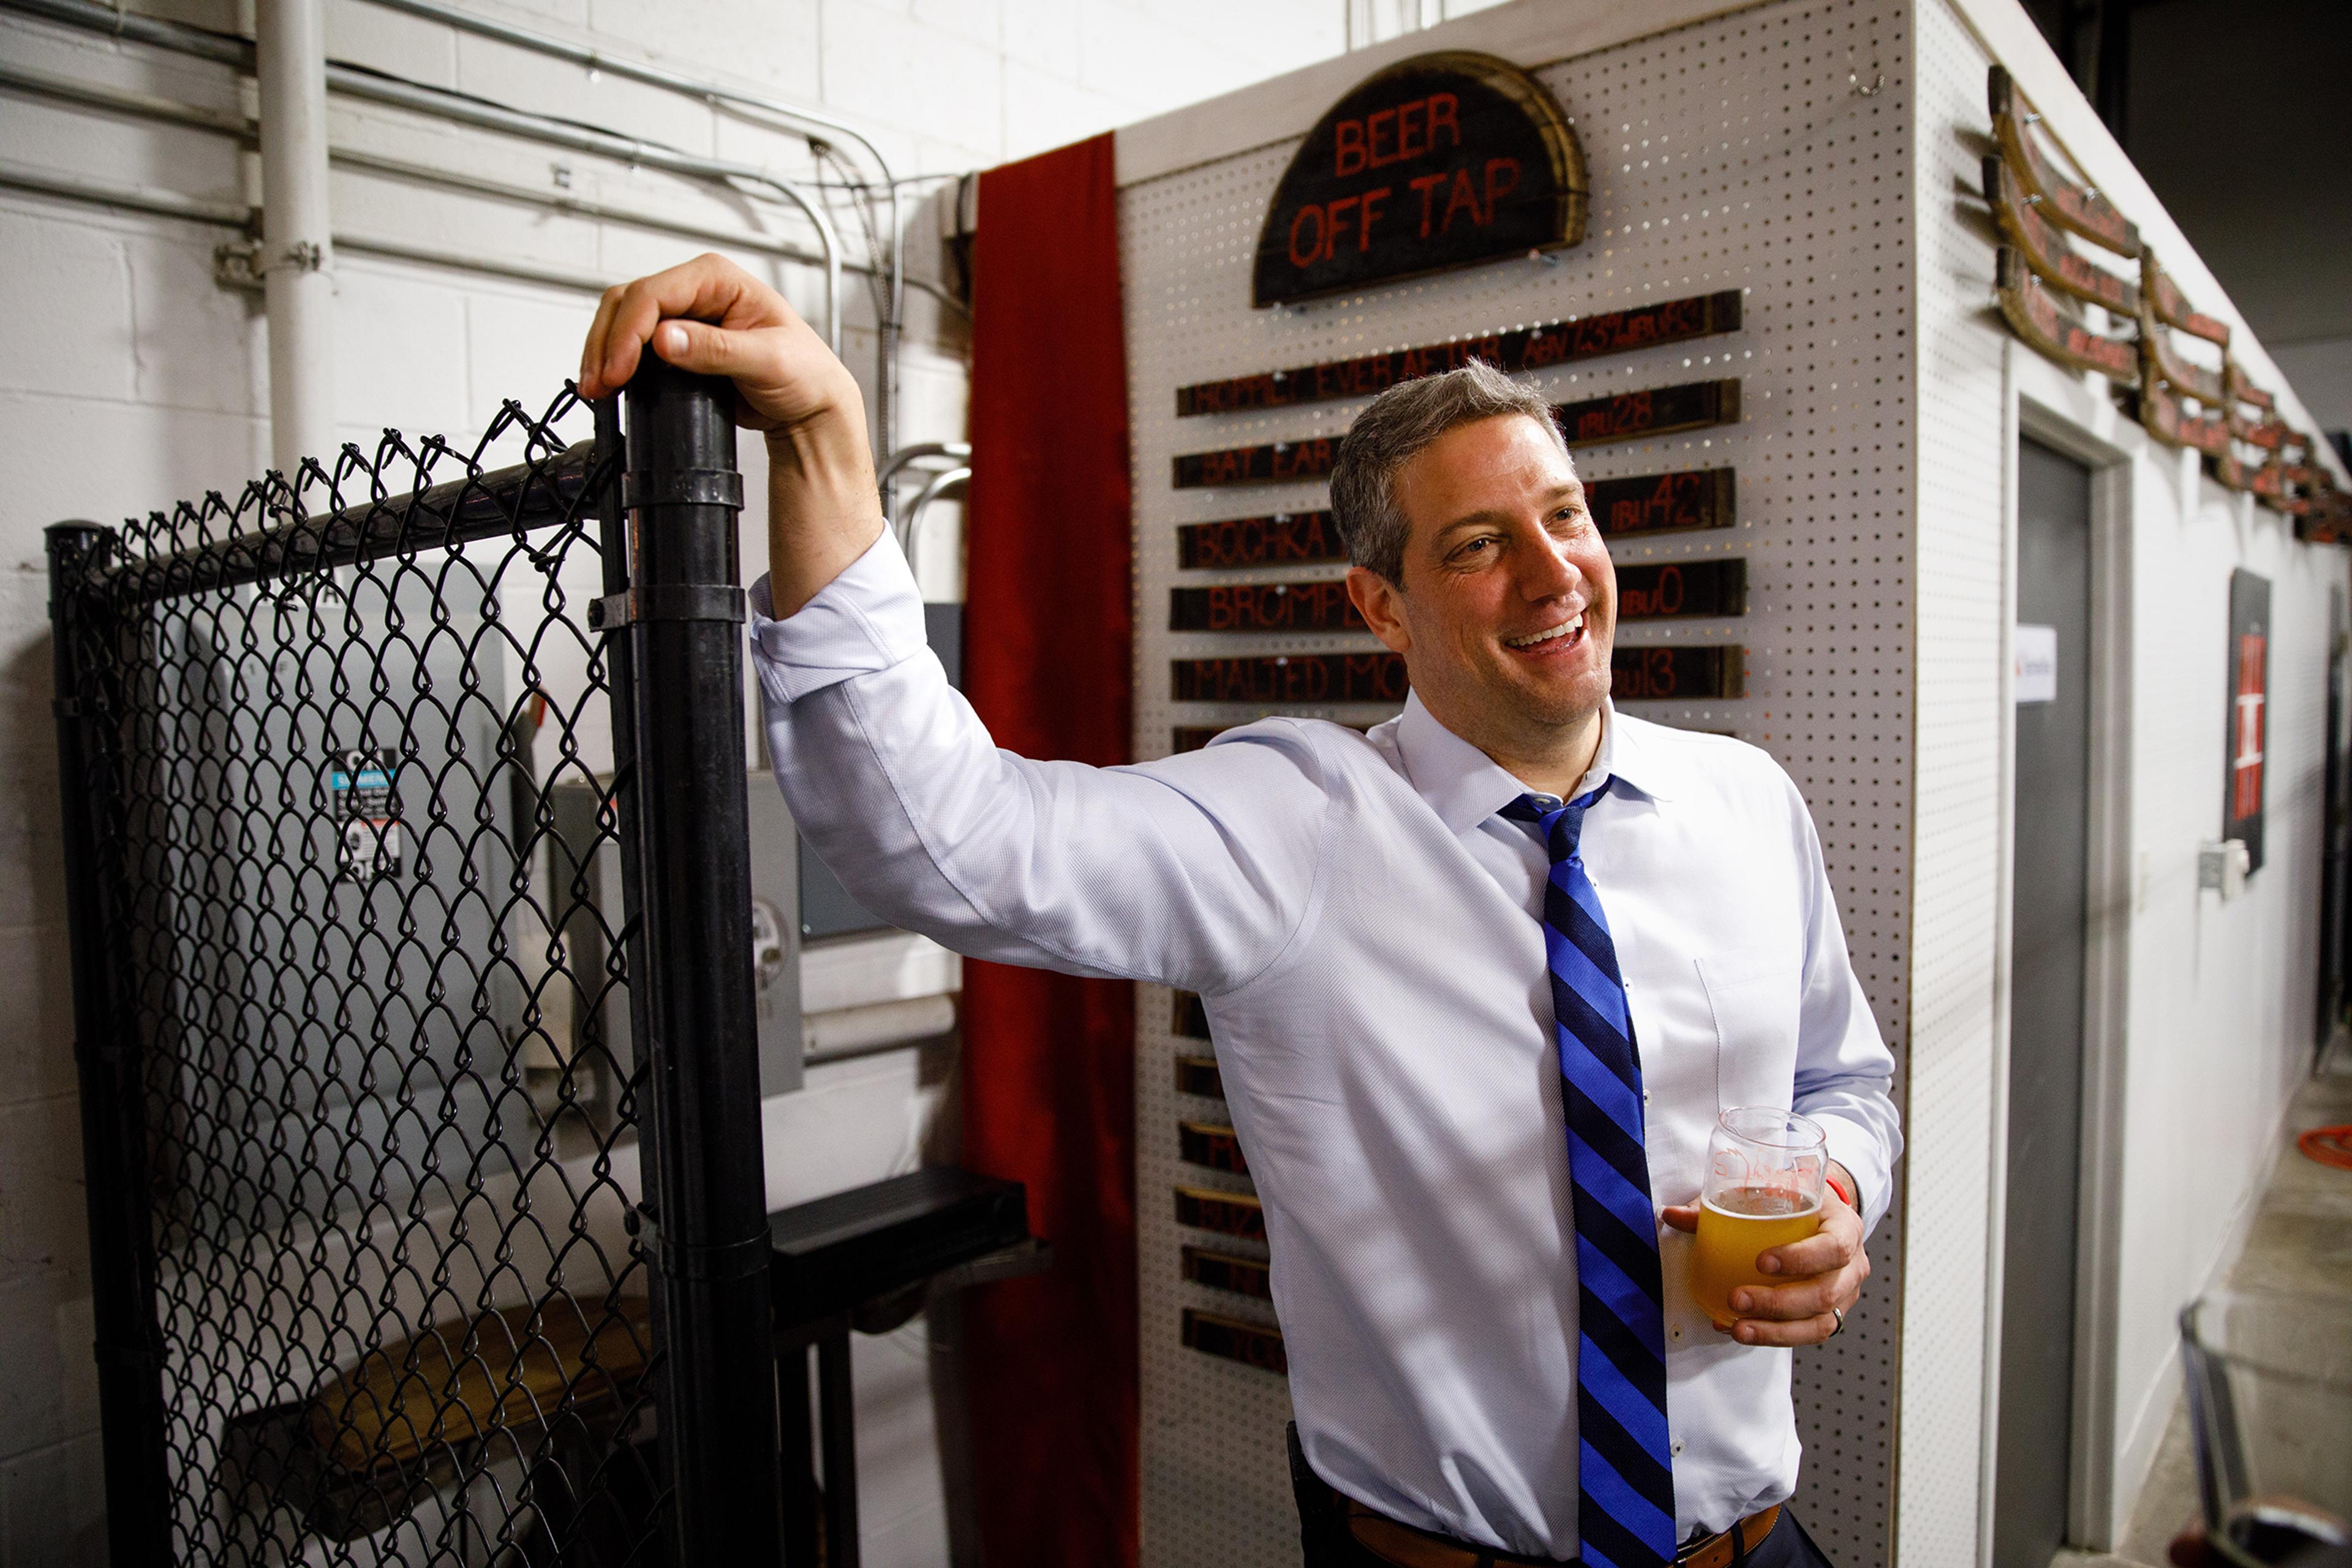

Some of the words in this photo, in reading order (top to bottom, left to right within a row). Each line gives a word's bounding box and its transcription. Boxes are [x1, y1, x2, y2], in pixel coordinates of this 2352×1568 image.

[1335, 92, 1460, 178] BEER
[1289, 187, 1392, 268] OFF
[1409, 157, 1522, 239] TAP
[1196, 655, 1328, 699] MALTED
